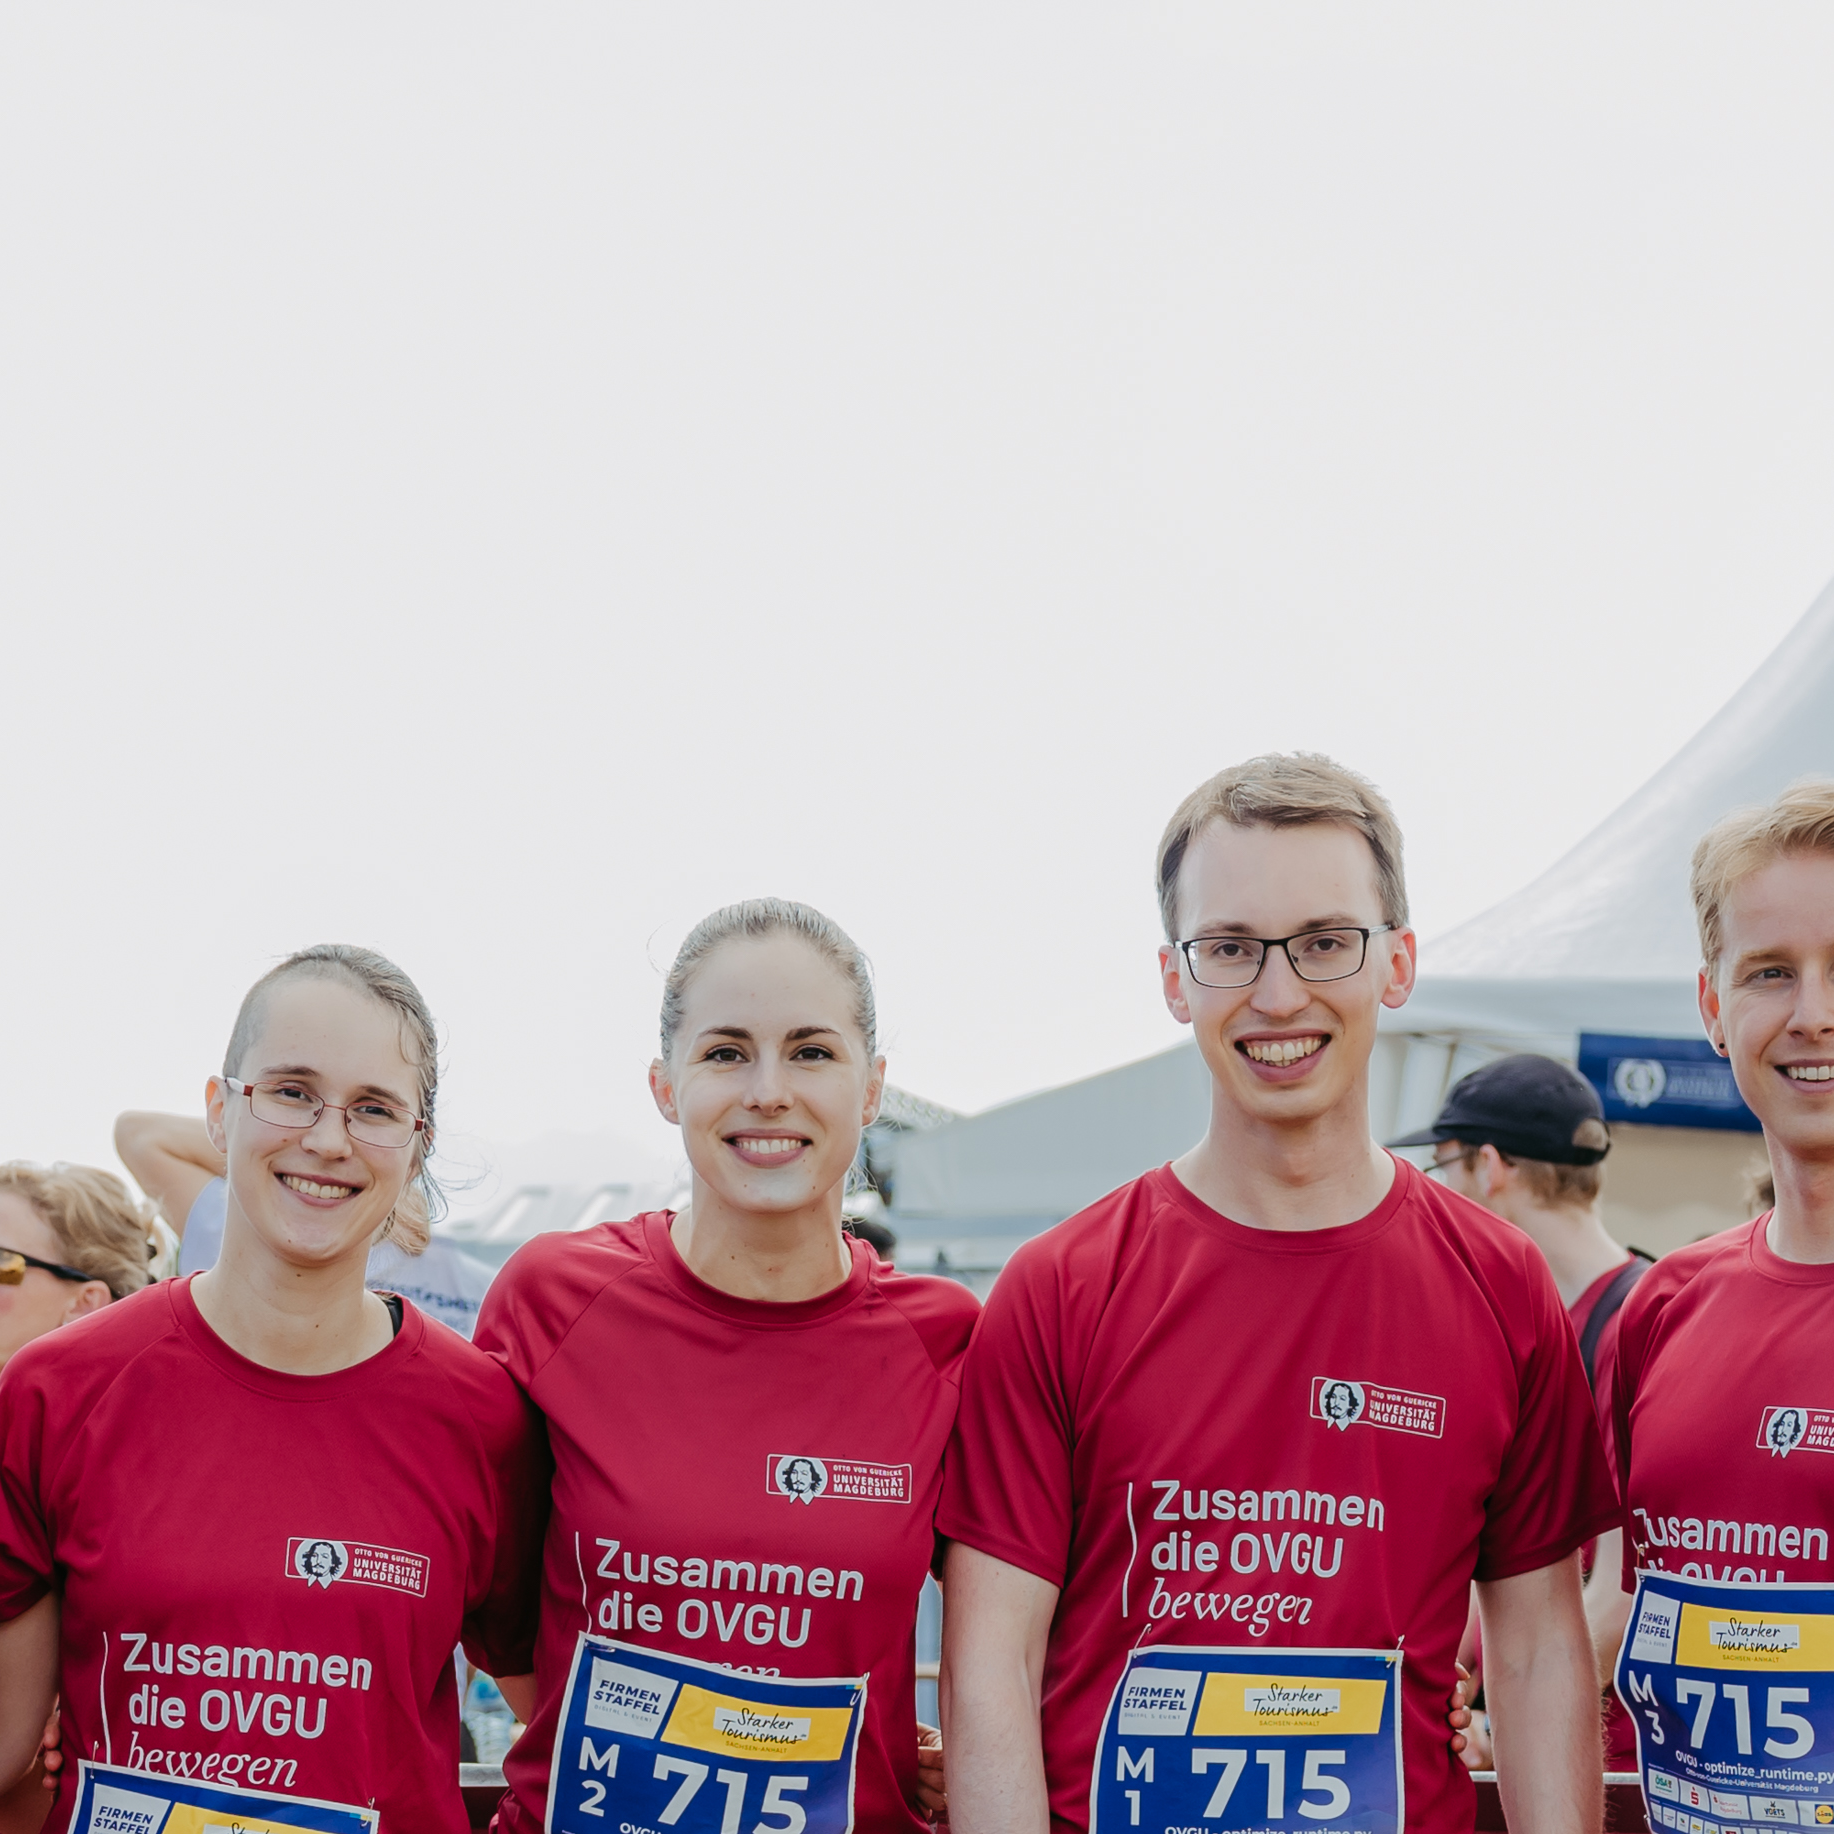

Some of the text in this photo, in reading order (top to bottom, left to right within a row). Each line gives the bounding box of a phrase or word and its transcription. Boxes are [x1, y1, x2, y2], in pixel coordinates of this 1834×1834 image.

[1369, 1399, 1437, 1421] UNIVERSITÄT
[1369, 1409, 1435, 1431] MAGDEBURG
[1813, 1414, 1830, 1423] OTTO
[832, 1464, 851, 1472] OTTO
[852, 1466, 868, 1474] VON
[832, 1474, 904, 1488] UNIVERSITÄT
[833, 1483, 904, 1497] MAGDEBURG
[1151, 1479, 1385, 1532] Zusammen
[354, 1547, 372, 1557] OTTO
[374, 1550, 389, 1559] VON
[1151, 1531, 1345, 1579] die OVGU
[352, 1568, 421, 1590] MAGDEBURG
[353, 1557, 422, 1580] UNIVERSITÄT
[594, 1537, 865, 1602] Zusammen
[1147, 1577, 1313, 1637] bewegen
[598, 1591, 813, 1648] die OVGU
[1637, 1622, 1672, 1640] STAFFEL
[1727, 1617, 1781, 1639] Starker
[1715, 1632, 1793, 1654] Tourismus
[120, 1632, 374, 1692] Zusammen
[1722, 1654, 1780, 1663] SACHSEN-ANHALT
[599, 1679, 662, 1703] FIRMEN
[1127, 1686, 1186, 1699] FIRMEN
[1267, 1683, 1323, 1703] Starker
[1628, 1670, 1659, 1707] M
[128, 1683, 328, 1740] die OVGU
[593, 1690, 660, 1715] STAFFEL
[1123, 1698, 1188, 1711] STAFFEL
[1253, 1698, 1335, 1718] Tourismus
[737, 1707, 794, 1731] Starker
[1644, 1709, 1666, 1745] 3
[1675, 1677, 1816, 1760] 715
[721, 1719, 803, 1745] Tourismus
[578, 1736, 620, 1779] M
[725, 1740, 788, 1754] SACHSEN-ANHALT
[127, 1731, 299, 1788] bewegen
[1116, 1745, 1155, 1783] M
[1191, 1748, 1351, 1820] 715
[1774, 1783, 1819, 1794] Magdeburg
[578, 1779, 607, 1817] 2
[1124, 1789, 1141, 1826] 1
[98, 1805, 154, 1825] FIRMEN
